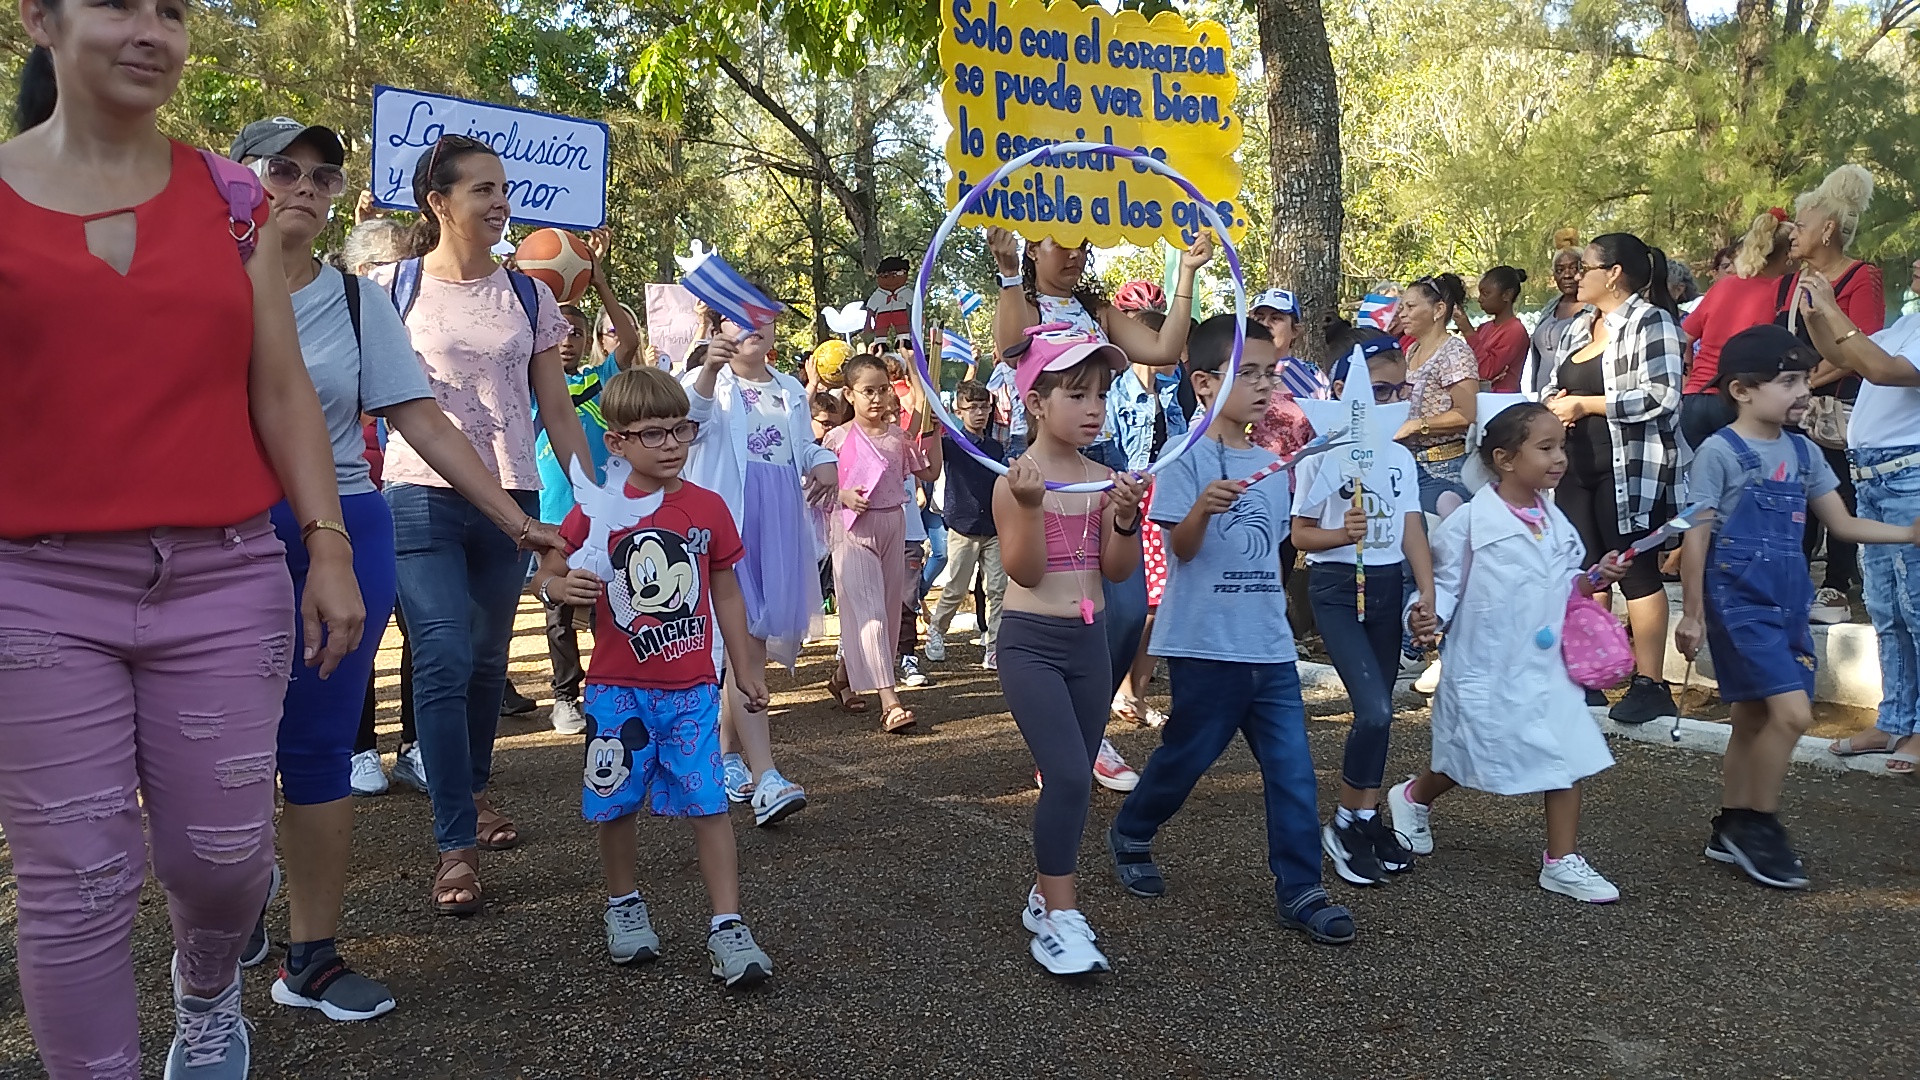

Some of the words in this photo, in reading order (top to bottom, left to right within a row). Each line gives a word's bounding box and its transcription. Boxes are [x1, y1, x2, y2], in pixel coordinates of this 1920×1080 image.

[952, 0, 1012, 53] Solo
[1019, 26, 1068, 61] con
[1074, 17, 1101, 64] el
[1108, 32, 1226, 75] corazón
[955, 63, 984, 97] se
[995, 63, 1082, 120] puede
[1091, 84, 1143, 118] ver
[1152, 72, 1231, 131] bien,
[389, 101, 445, 147] La
[959, 106, 984, 158] lo
[383, 167, 406, 201] y
[507, 180, 570, 211] mor
[1091, 197, 1110, 227] a
[1118, 180, 1163, 228] los
[687, 527, 711, 555] 28
[629, 616, 706, 662] MICKEY
[662, 635, 705, 661] MOUSE
